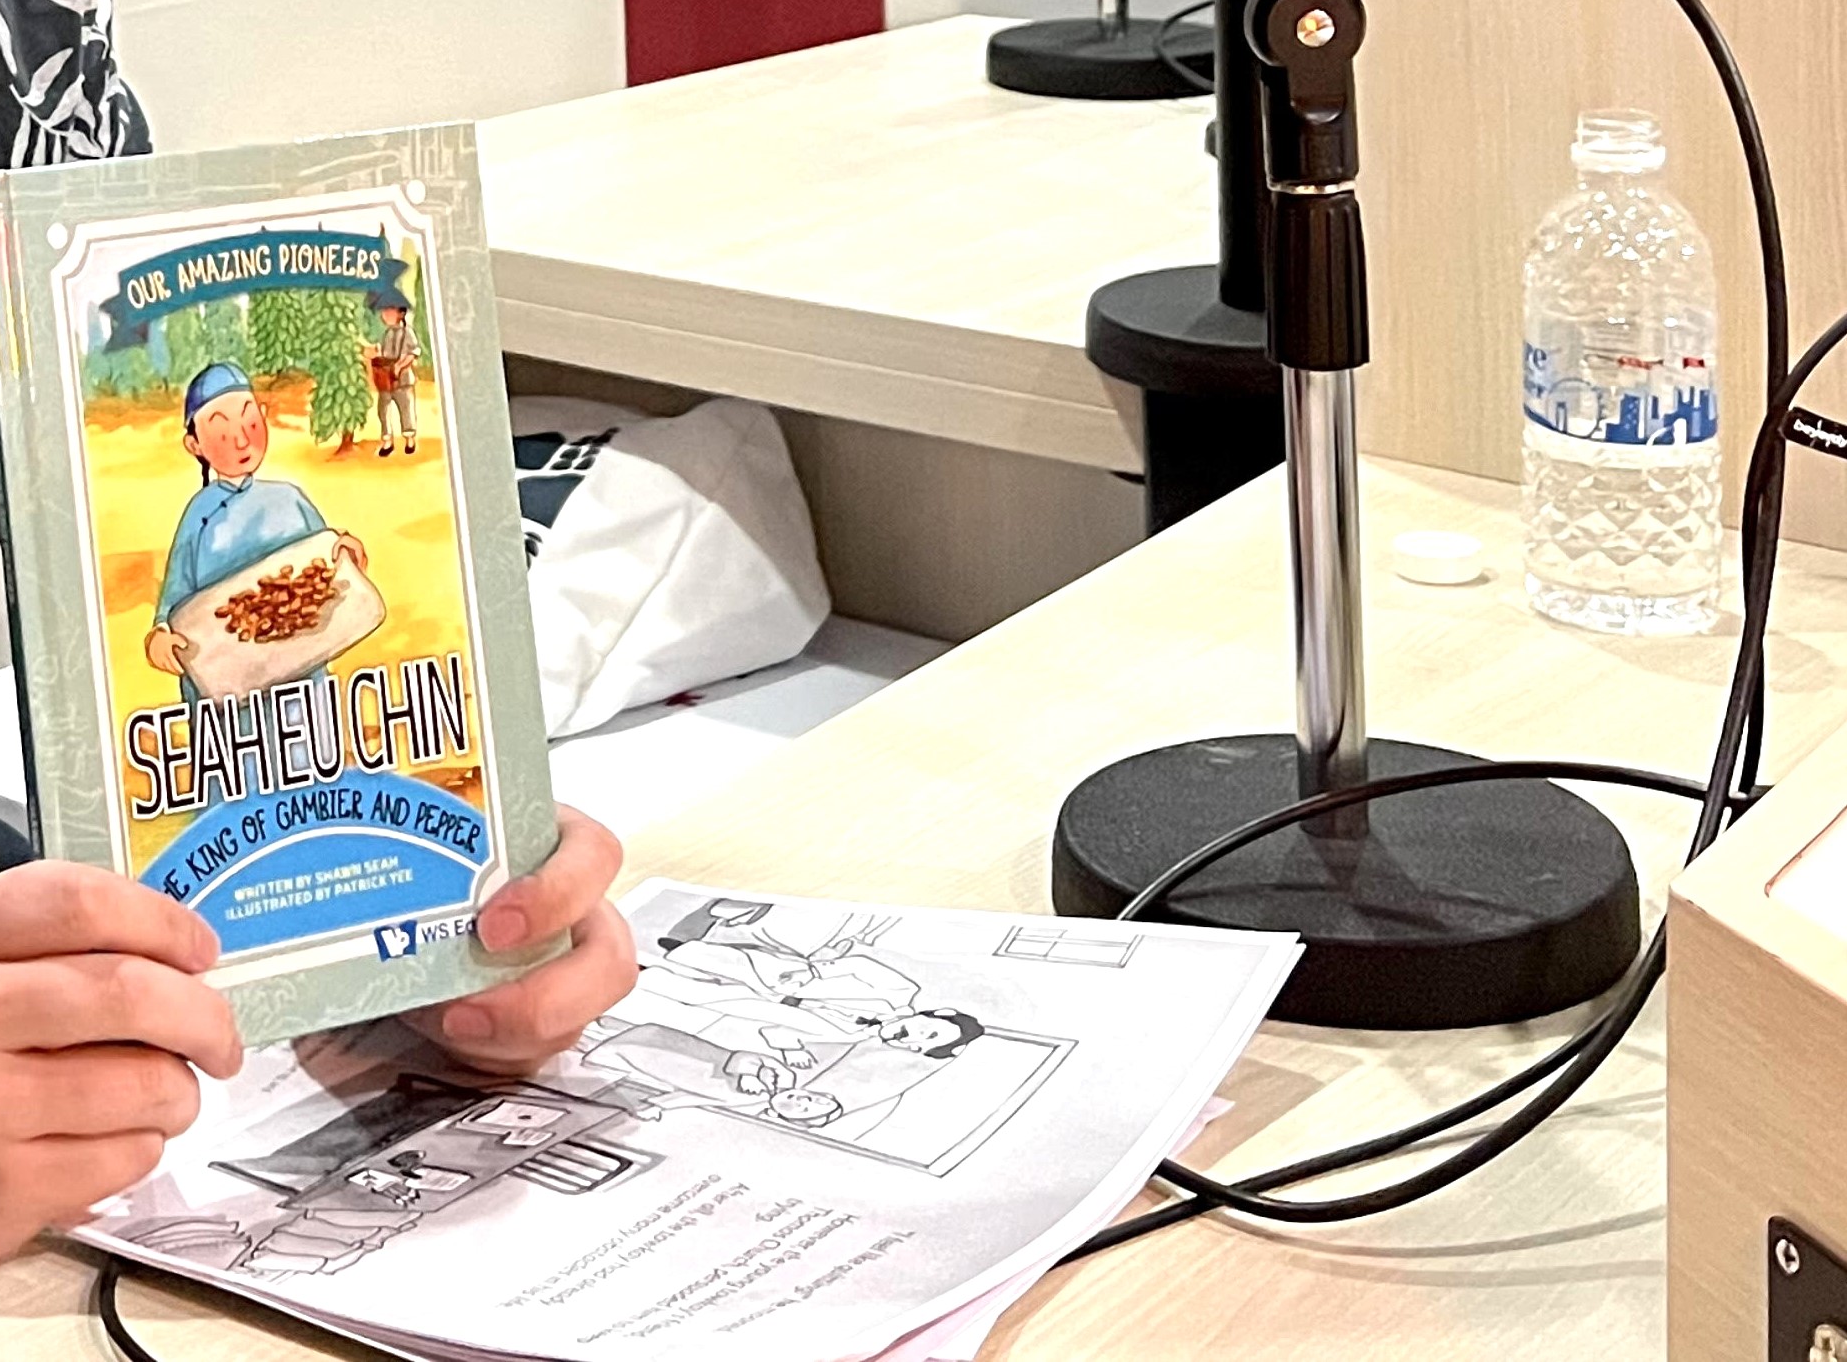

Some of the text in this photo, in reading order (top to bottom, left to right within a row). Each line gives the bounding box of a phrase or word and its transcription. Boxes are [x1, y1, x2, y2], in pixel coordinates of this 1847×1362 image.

[126, 244, 381, 309] OUR AMAZING PIONEERS
[128, 655, 467, 817] SEAH EU CHIN
[185, 827, 239, 882] KING
[242, 809, 267, 844] OF
[275, 789, 364, 831] GAMBIER
[371, 790, 410, 826] AND
[414, 801, 481, 854] PEPPER
[225, 868, 414, 921] ILLUSTRATED BY PATRICK YEE
[234, 877, 293, 901] WRITTEN
[296, 874, 312, 889] BY
[315, 862, 362, 885] SHAWN
[421, 923, 449, 943] WS
